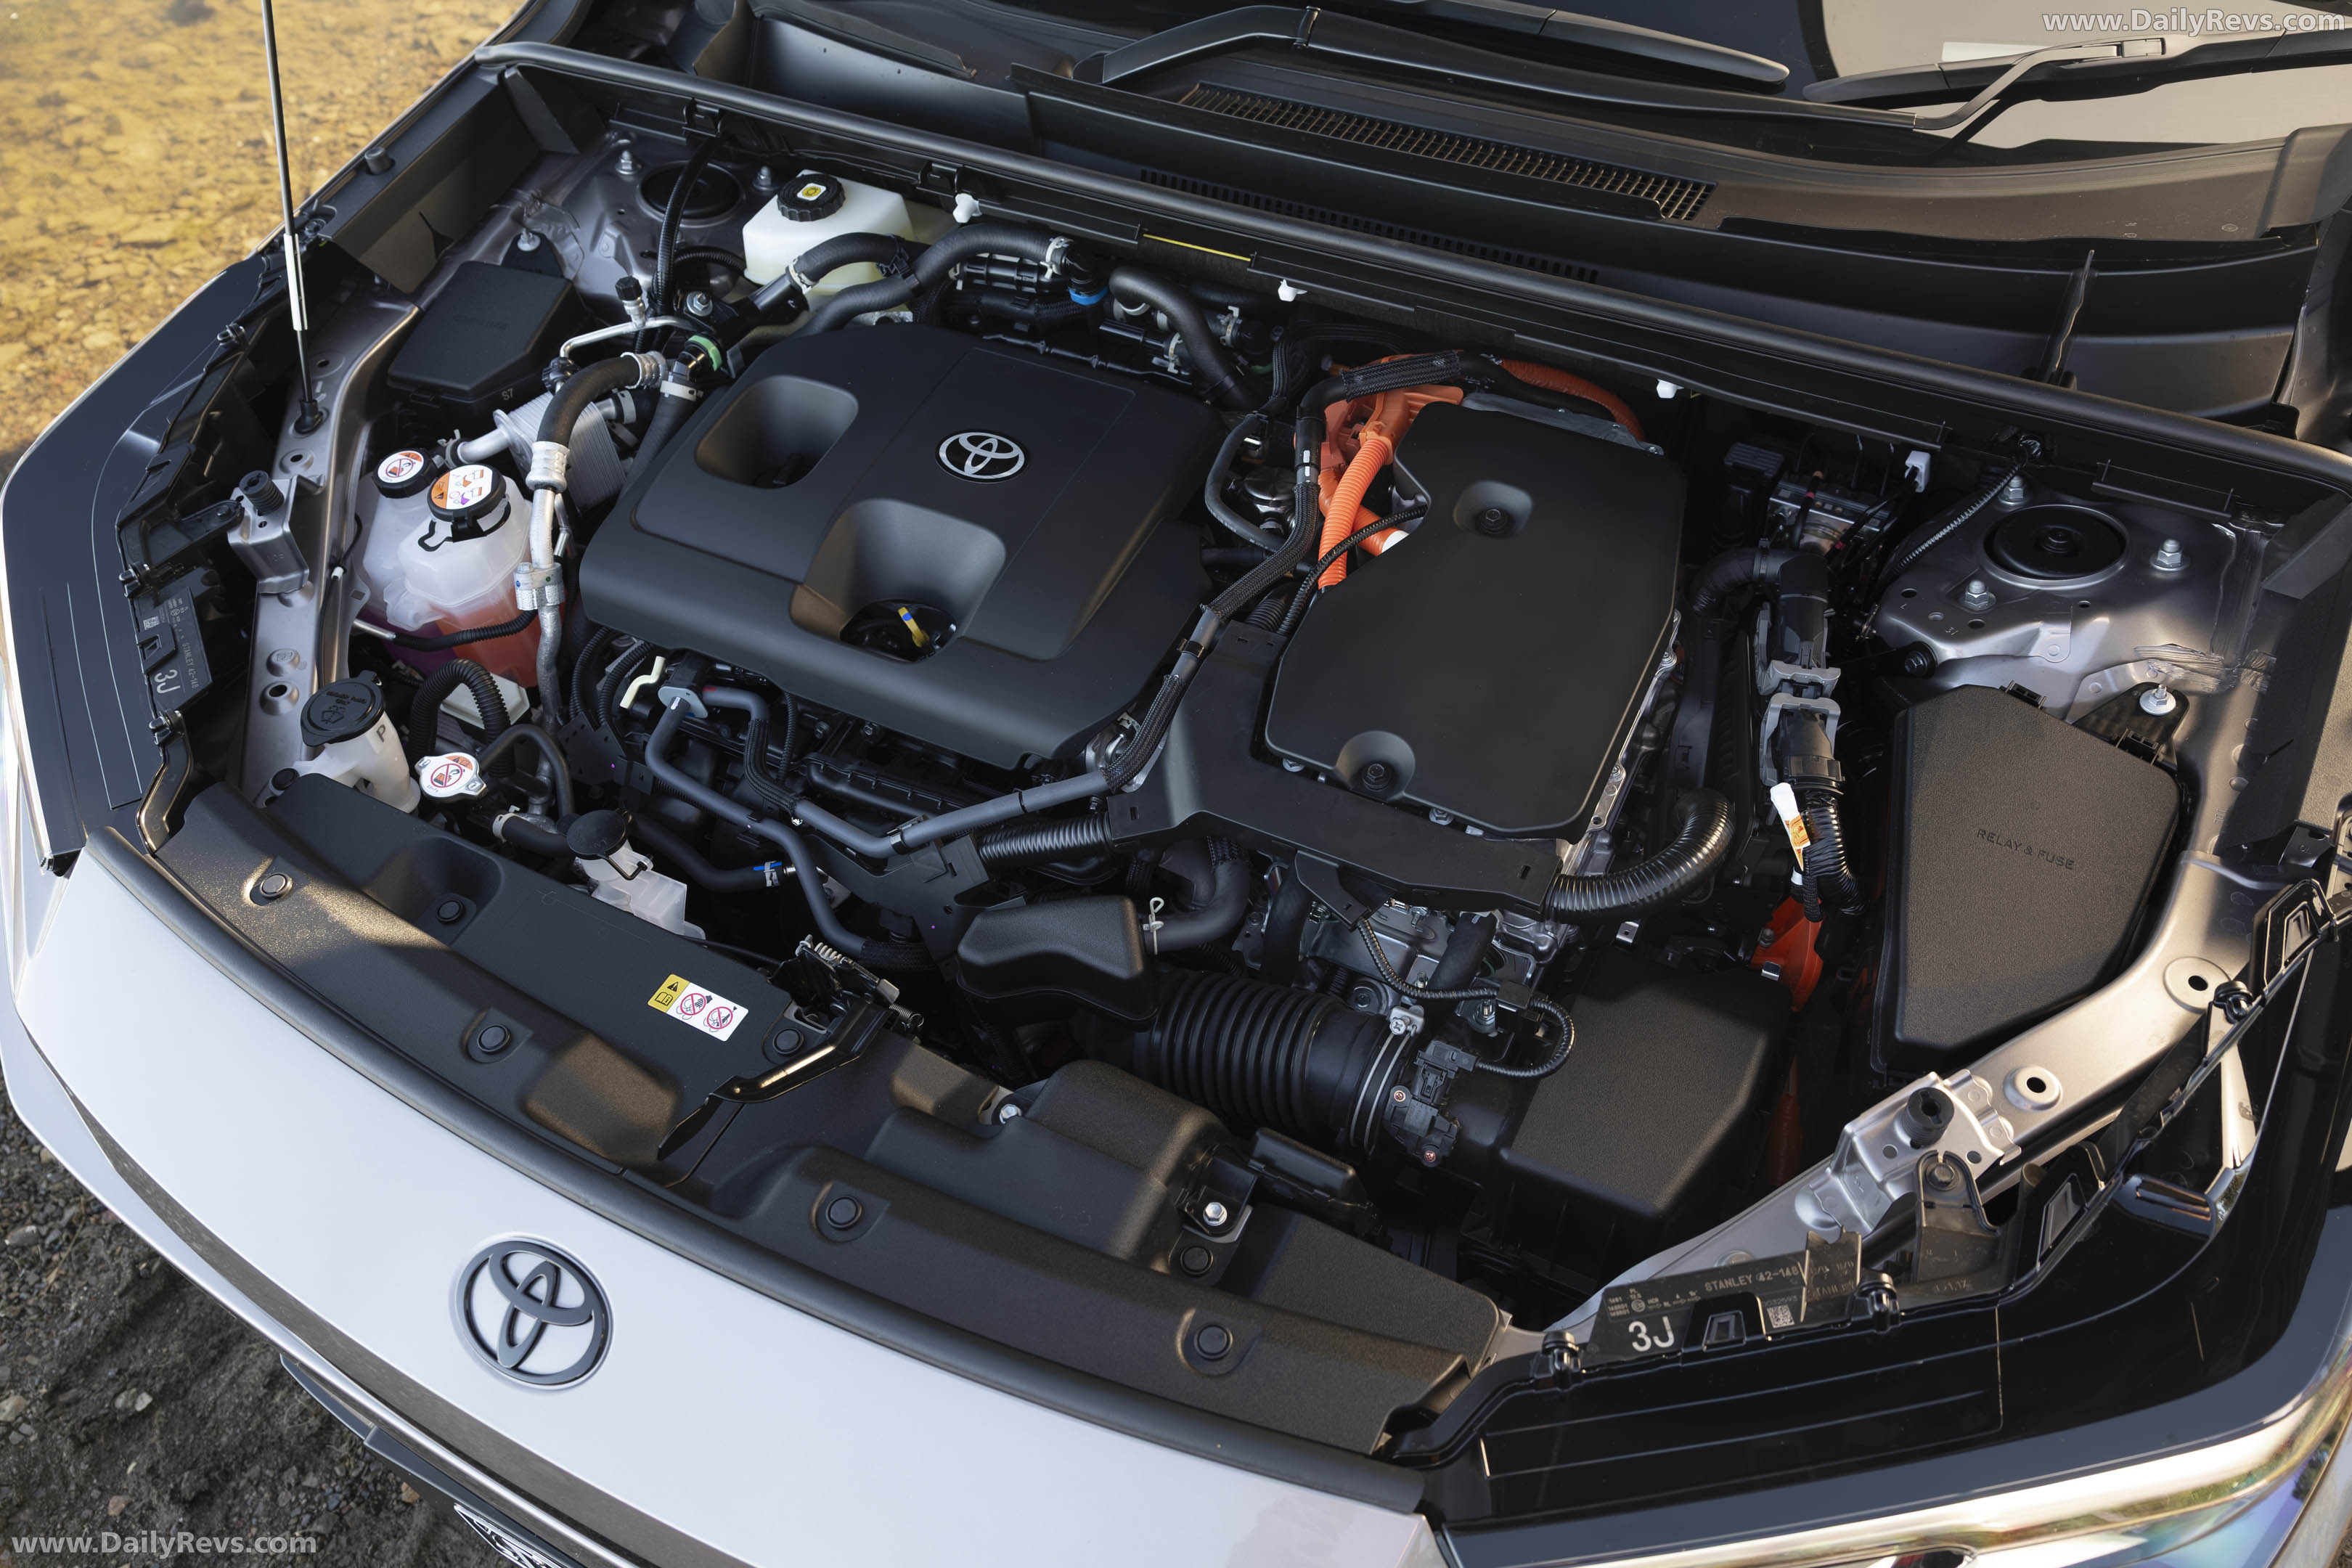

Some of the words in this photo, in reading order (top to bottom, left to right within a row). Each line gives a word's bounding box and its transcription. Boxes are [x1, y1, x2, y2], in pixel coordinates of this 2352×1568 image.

[154, 669, 181, 694] 3J
[376, 724, 386, 743] P
[1977, 828, 2022, 852] RELAY
[2024, 846, 2033, 856] &
[2037, 849, 2075, 870] FUSE
[1704, 1274, 1752, 1291] STANLEY
[1757, 1266, 1799, 1282] 42-148
[1628, 1316, 1675, 1352] 3J
